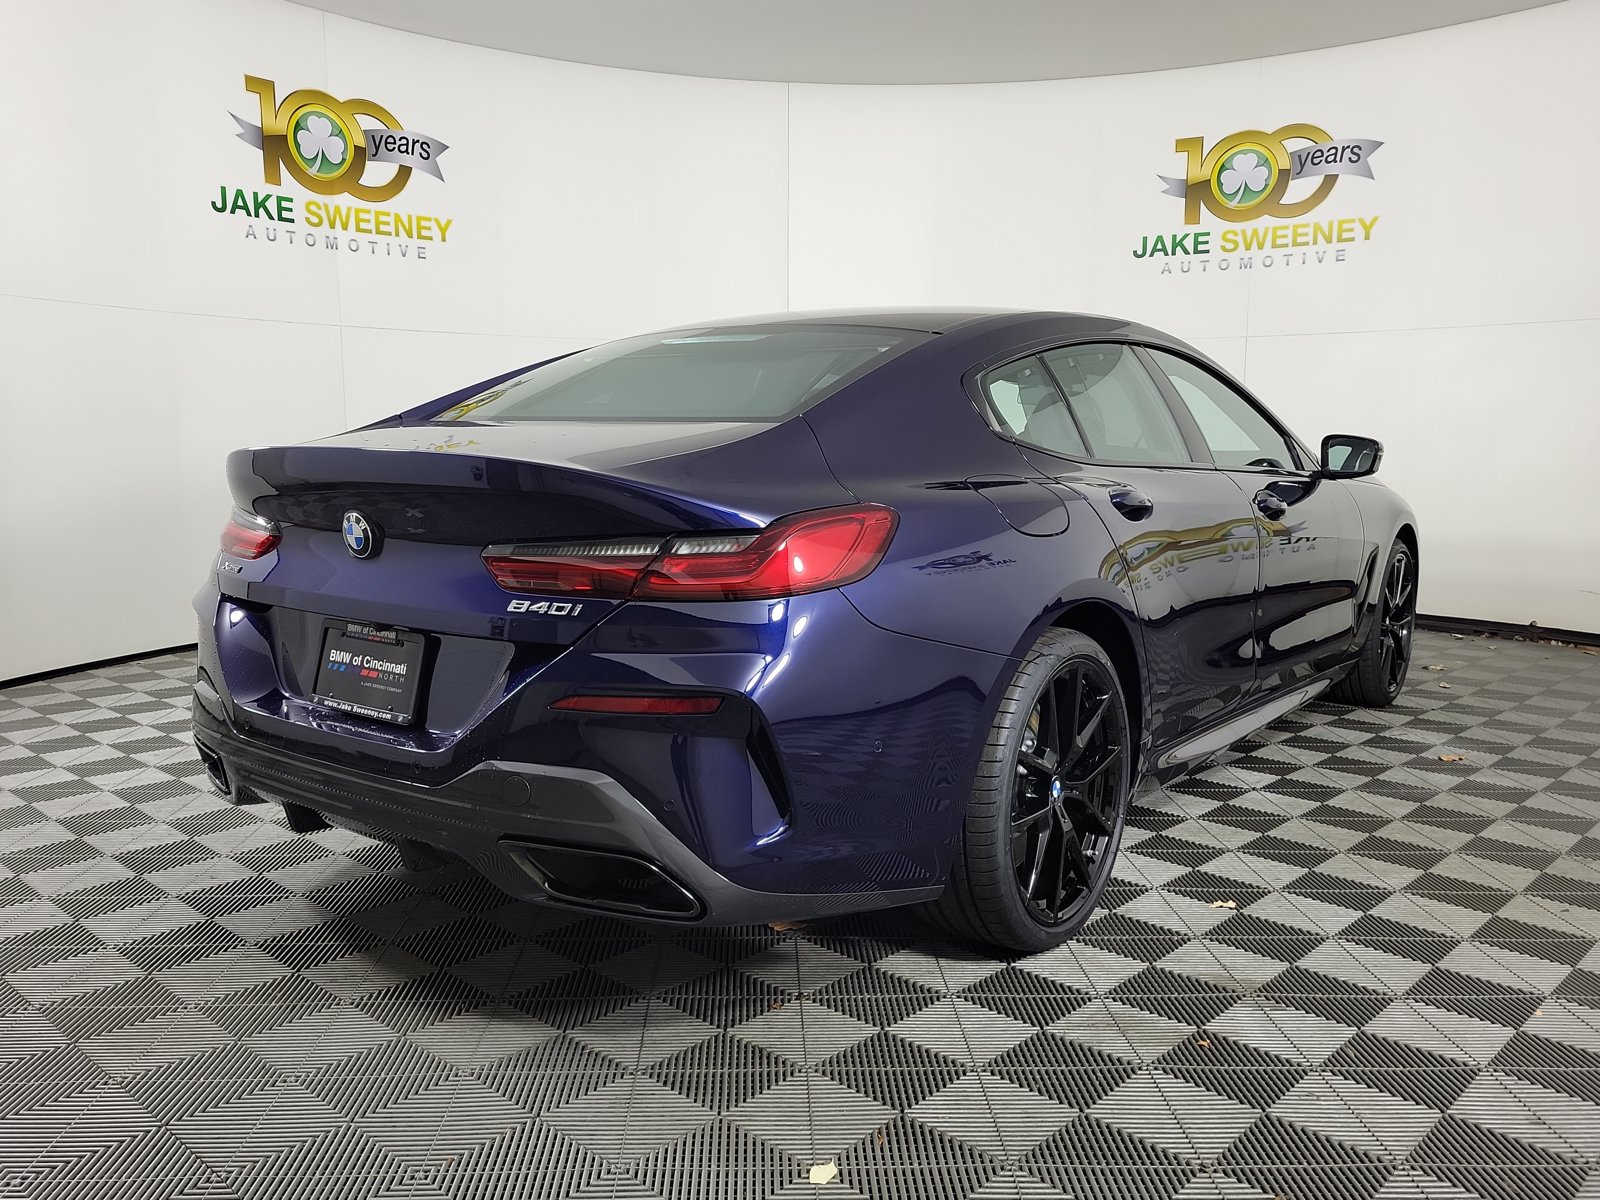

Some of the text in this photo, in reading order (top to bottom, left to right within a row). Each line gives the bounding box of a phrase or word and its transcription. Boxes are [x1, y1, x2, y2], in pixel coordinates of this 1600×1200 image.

[244, 74, 431, 202] 100 years
[1175, 123, 1362, 225] 100 years
[210, 186, 453, 243] JAKE SWEENEY
[245, 224, 427, 260] AUTOMOTIVE
[1132, 215, 1380, 259] JAKE SWEENEY
[1160, 249, 1347, 275] AUTOMOTIVE
[506, 599, 584, 616] 840i
[347, 623, 363, 633] BMW
[363, 626, 370, 634] of
[329, 649, 407, 675] BMW of Cincinnati
[379, 672, 405, 684] NORTH
[323, 700, 352, 711] www.Jake
